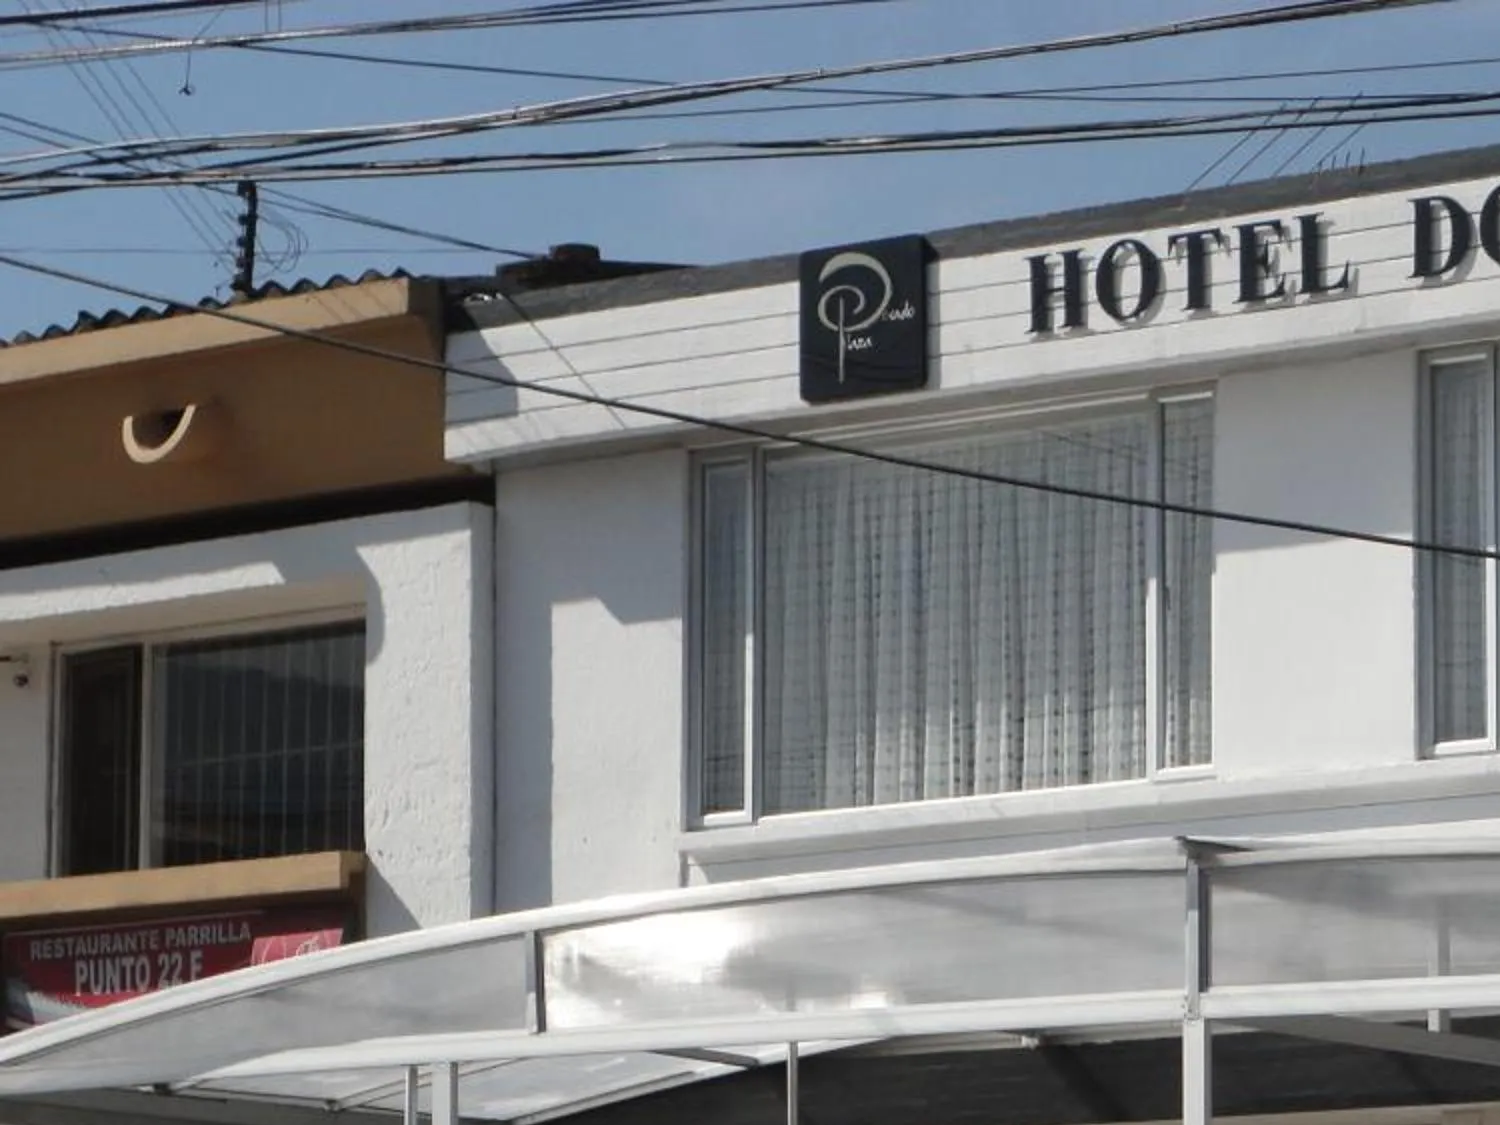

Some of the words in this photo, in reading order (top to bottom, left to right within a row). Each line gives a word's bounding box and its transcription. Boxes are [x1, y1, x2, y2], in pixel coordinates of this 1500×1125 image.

[1025, 212, 1352, 335] HOTEL
[30, 929, 159, 960] RESTAURANTE
[165, 921, 251, 948] PARRILLA
[75, 954, 150, 997] PUNTO
[158, 952, 183, 990] 22
